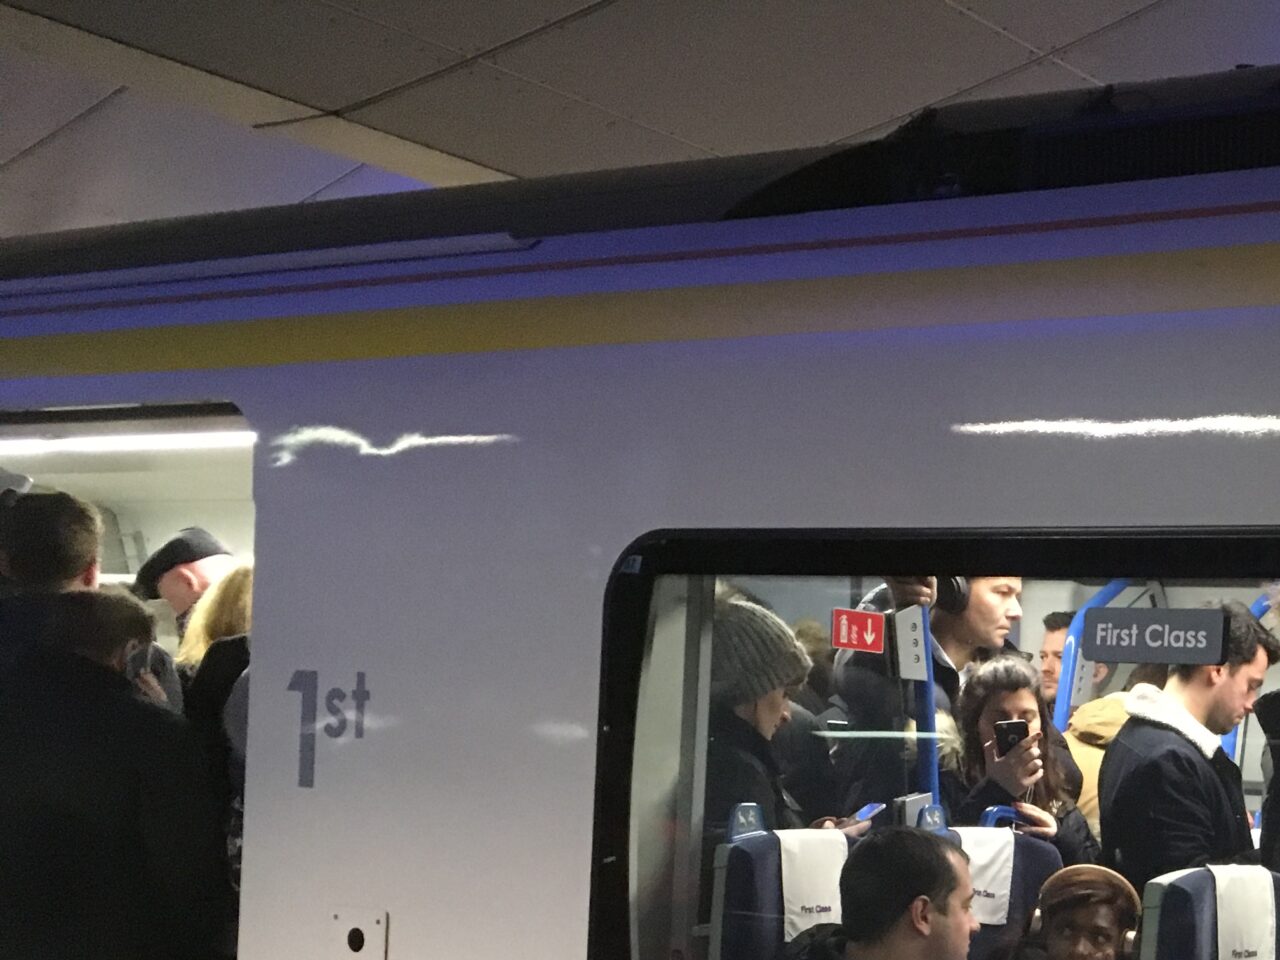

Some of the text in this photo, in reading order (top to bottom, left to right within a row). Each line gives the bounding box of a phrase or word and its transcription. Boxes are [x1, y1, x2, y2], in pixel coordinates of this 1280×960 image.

[1096, 623, 1207, 648] First Class
[287, 669, 370, 788] 1st
